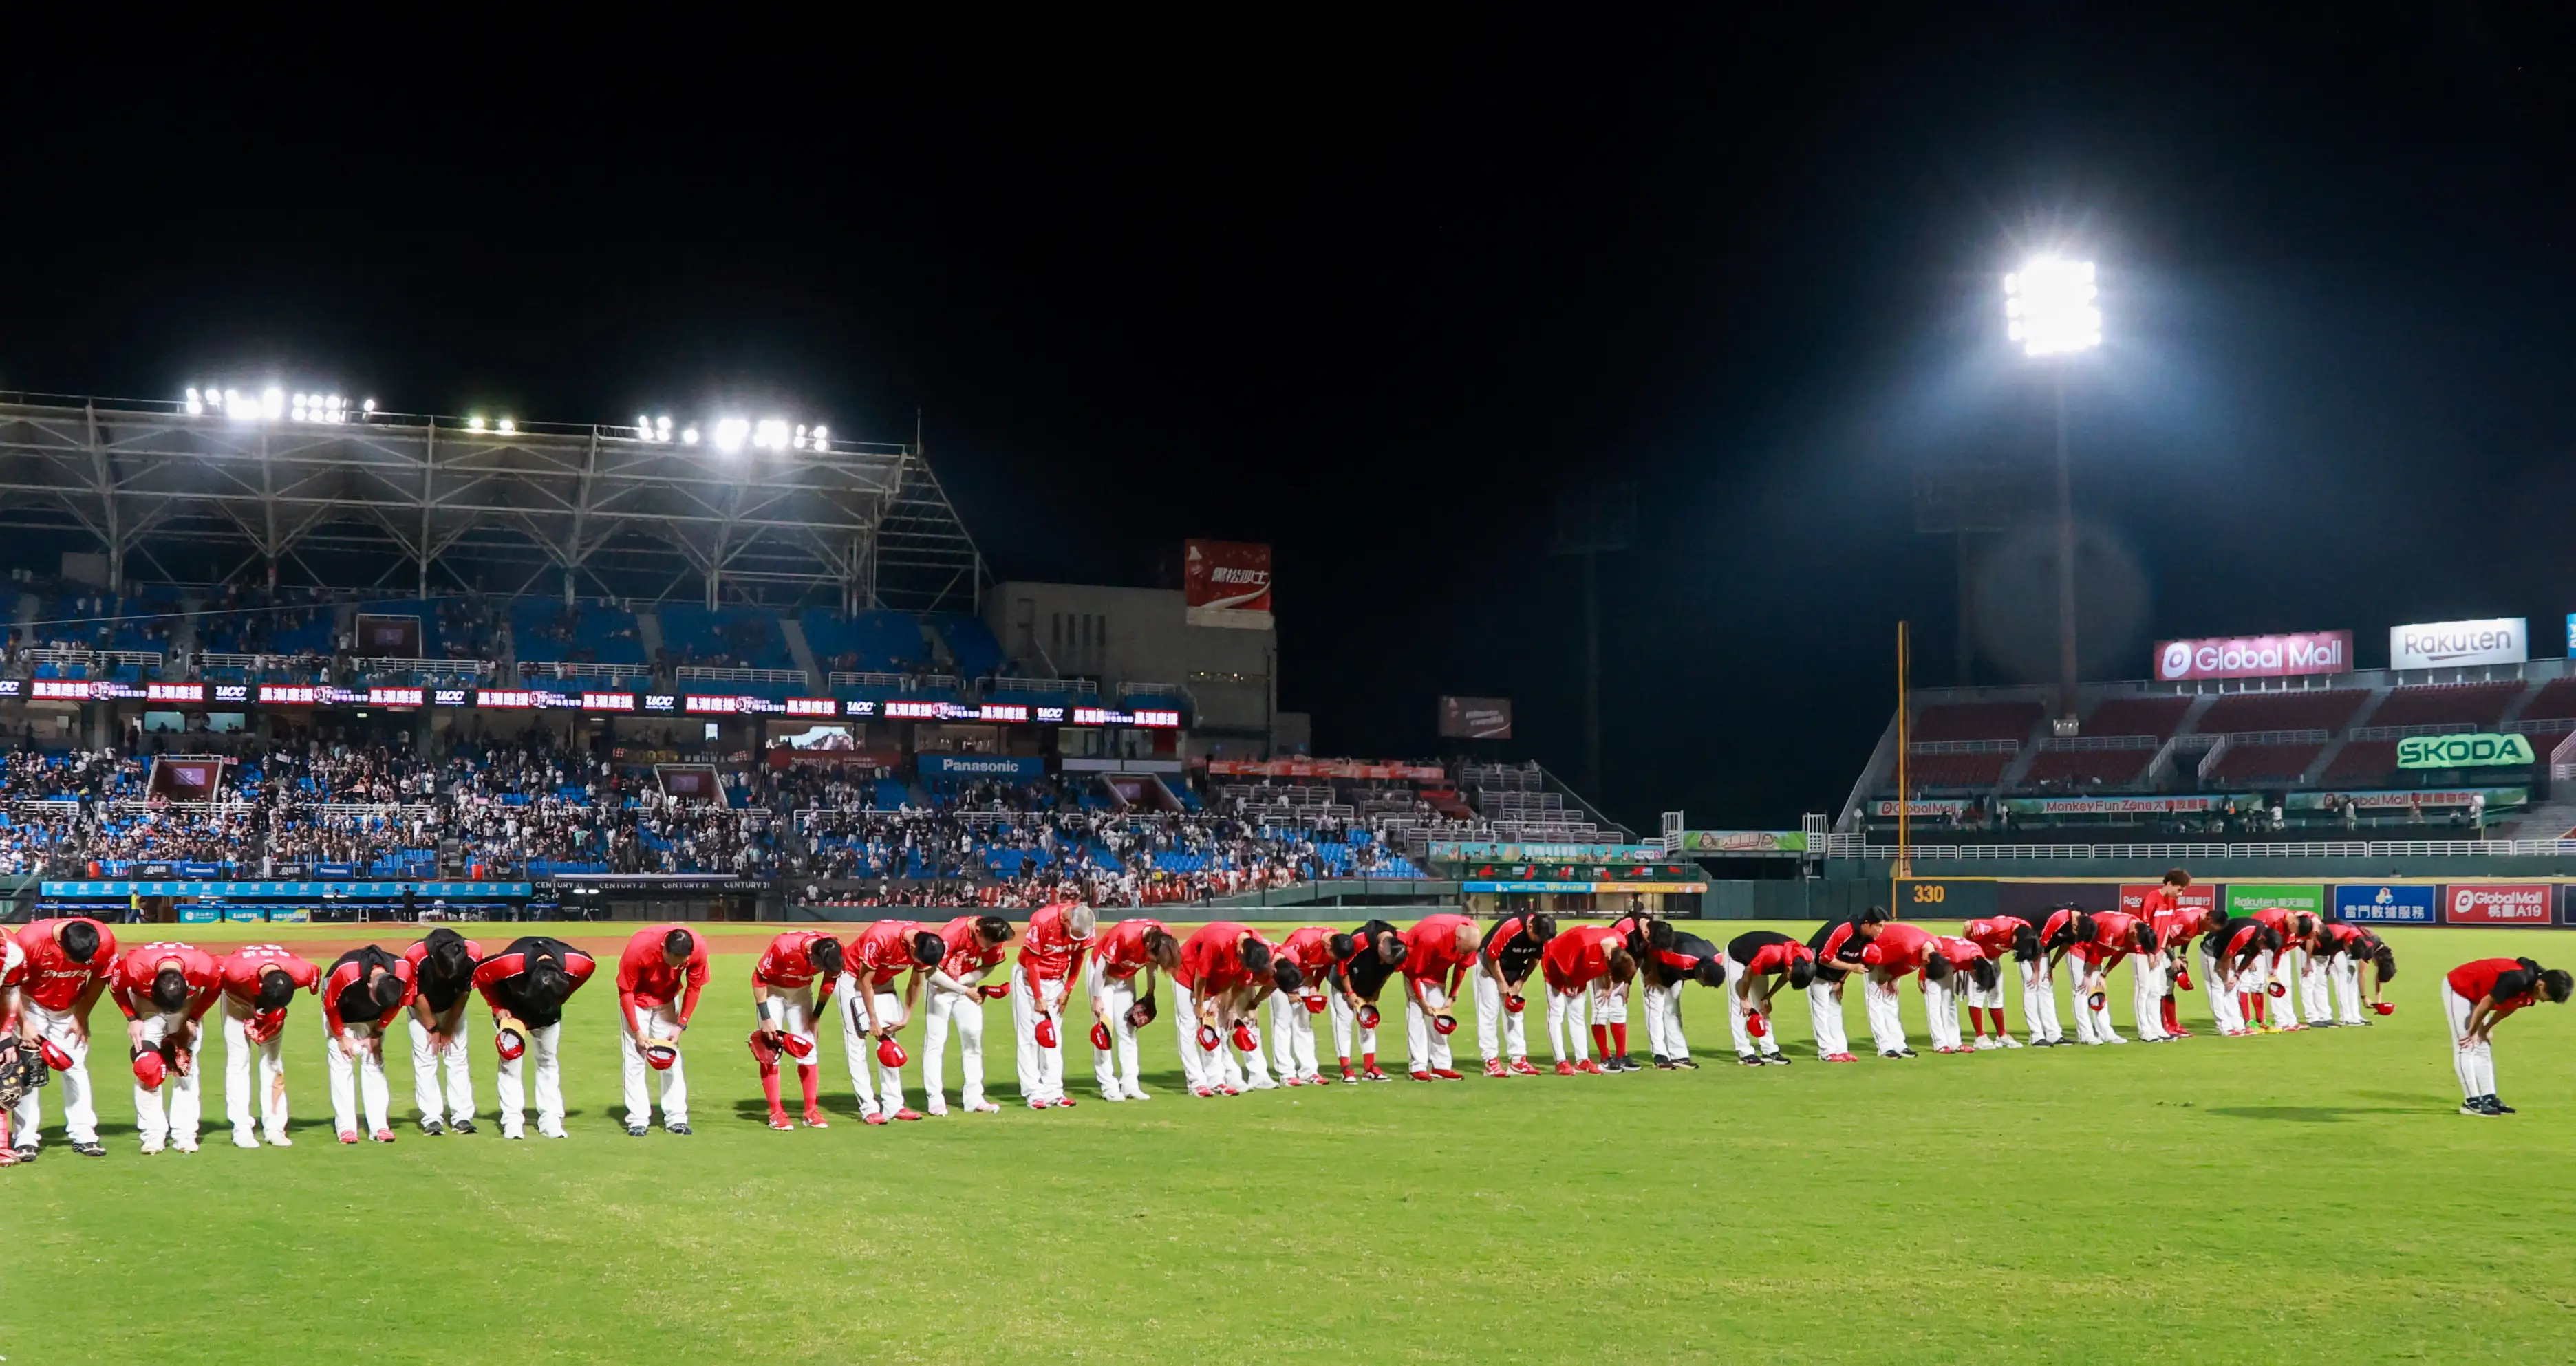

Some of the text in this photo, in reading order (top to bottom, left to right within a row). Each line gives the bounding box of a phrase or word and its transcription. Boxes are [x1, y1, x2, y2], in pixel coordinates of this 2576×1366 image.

[2405, 630, 2511, 655] Rakuten
[2195, 640, 2342, 671] Global Mall
[0, 680, 19, 691] CC
[943, 759, 1019, 773] Panasonic
[1893, 801, 1931, 814] Gobal
[2046, 801, 2094, 813] Monkey
[2096, 800, 2120, 812] Fun
[2121, 799, 2152, 811] Zone
[1913, 885, 1945, 903] 330
[2474, 891, 2542, 904] Global Mall
[2233, 896, 2275, 907] Rakuten
